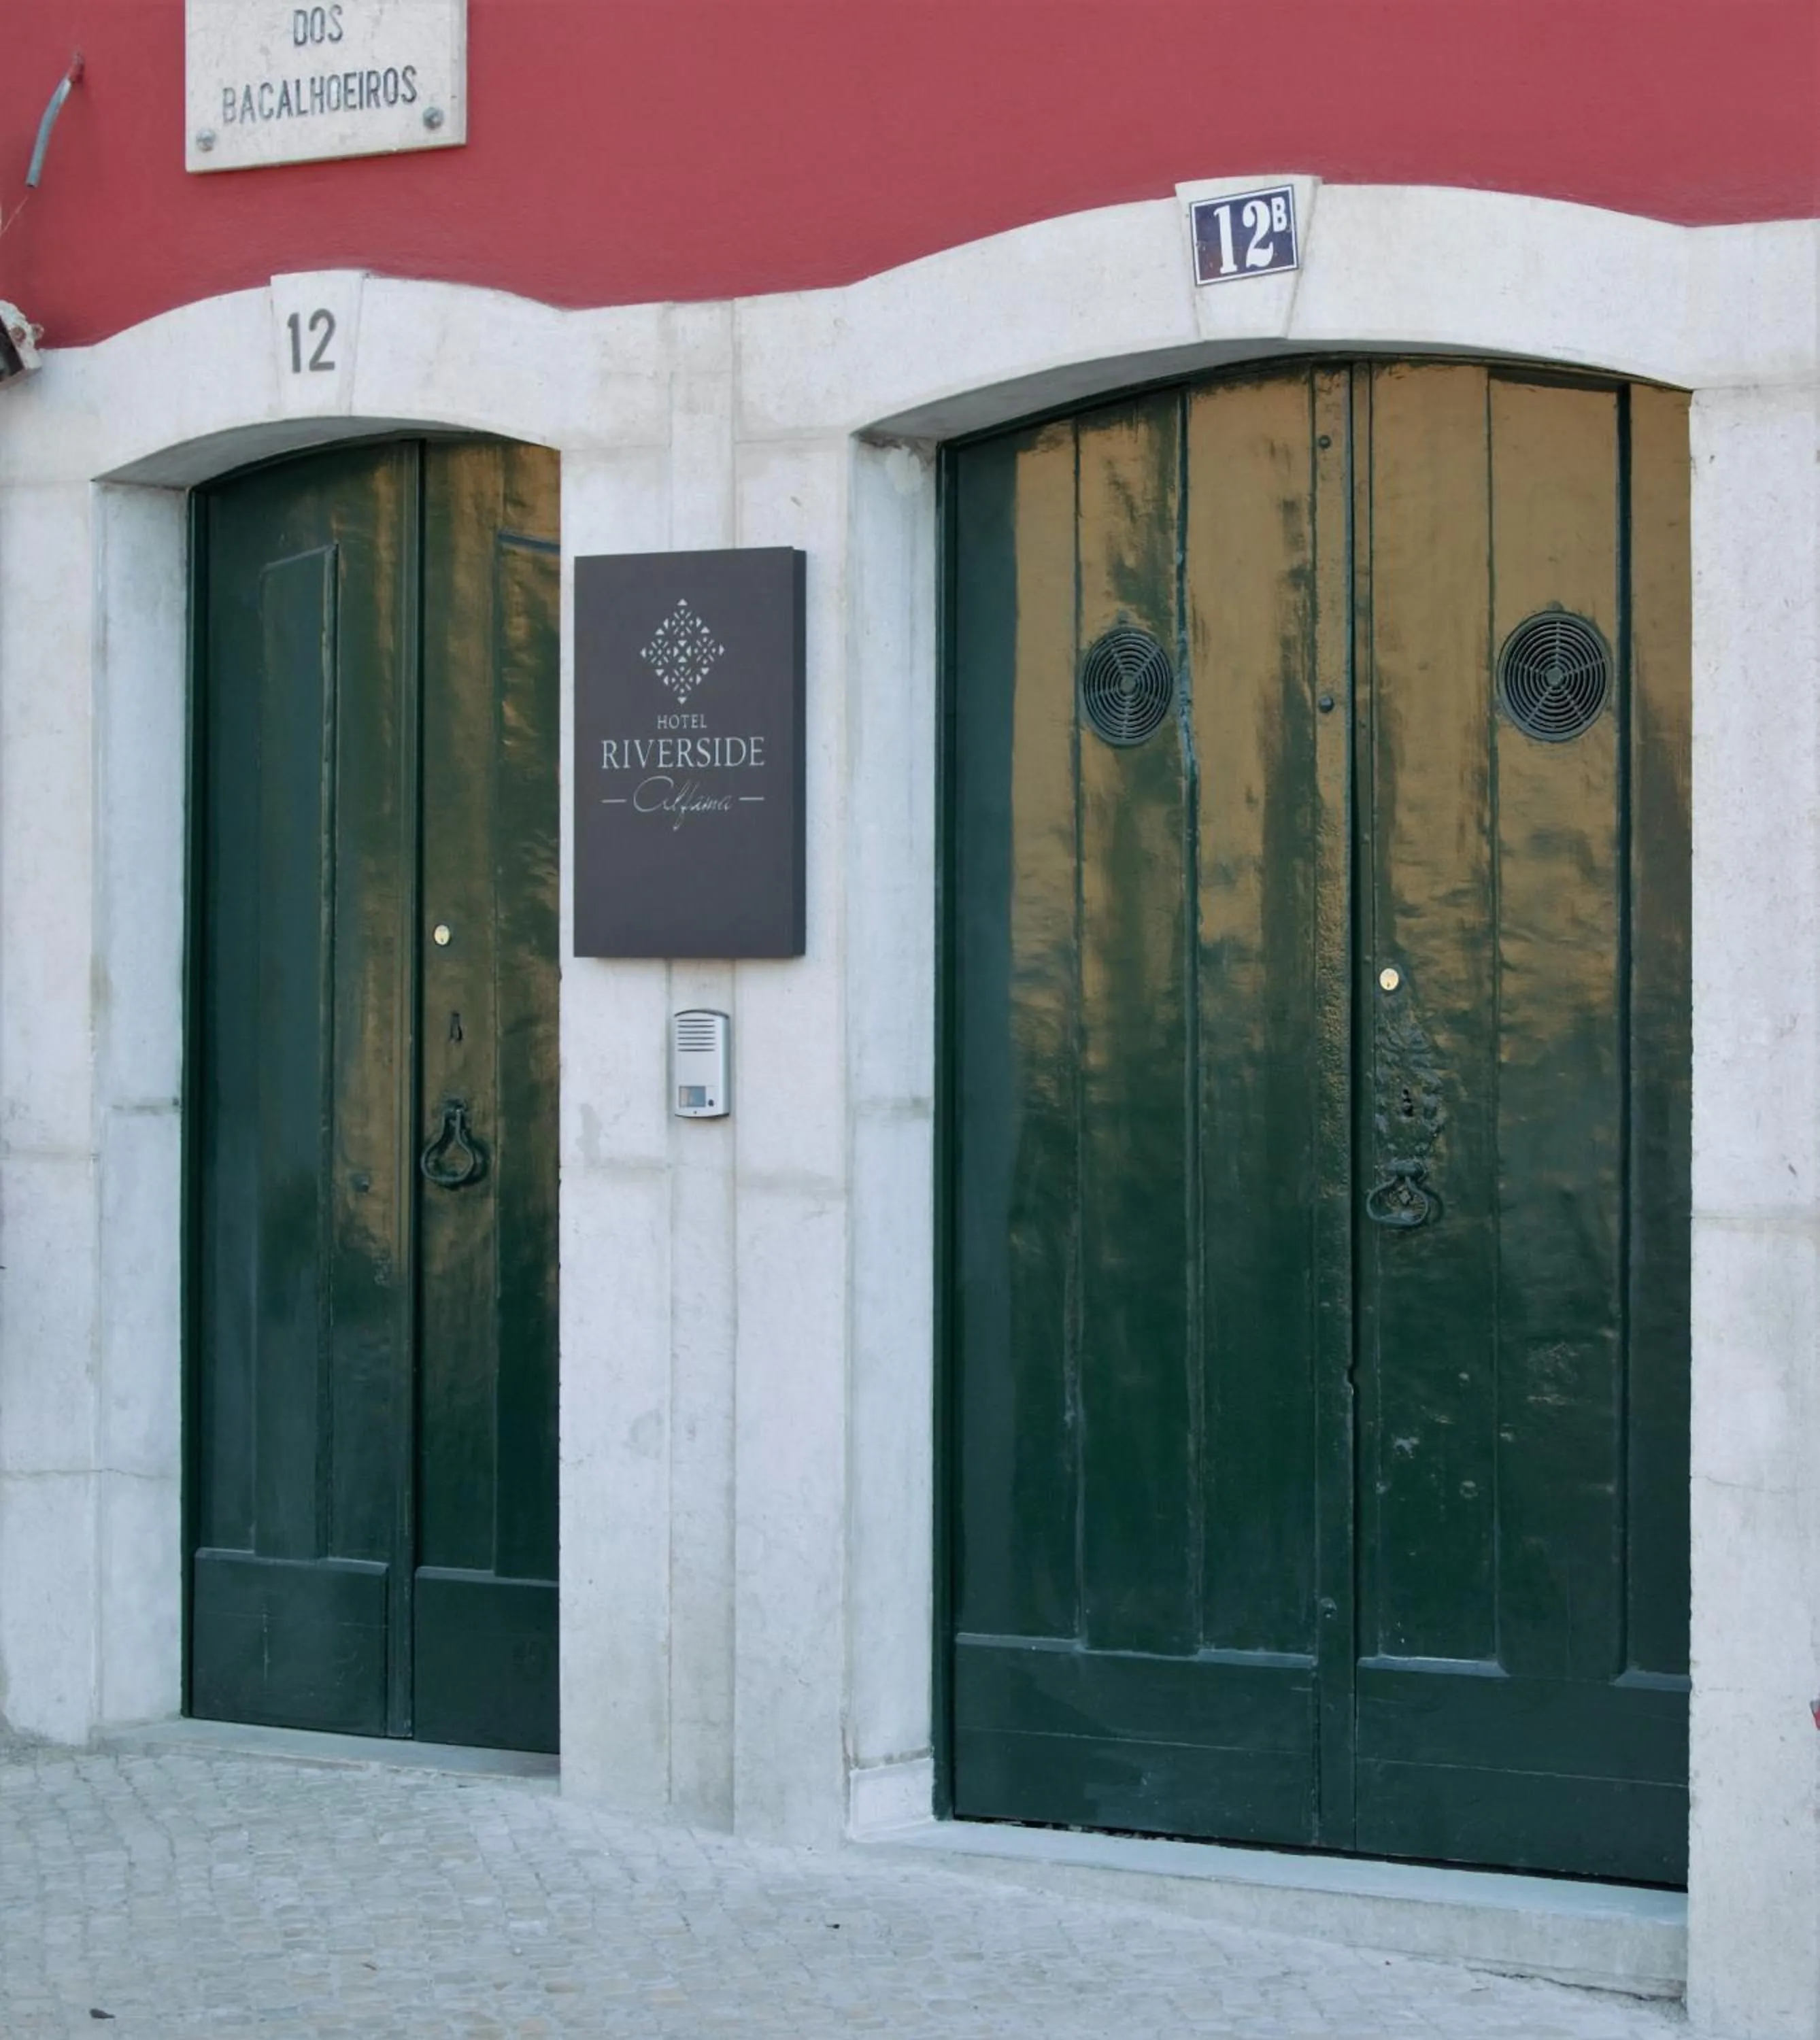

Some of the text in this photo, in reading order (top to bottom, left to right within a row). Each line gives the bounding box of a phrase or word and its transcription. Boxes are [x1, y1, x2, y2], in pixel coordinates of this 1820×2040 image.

[293, 4, 344, 46] DOS
[222, 65, 417, 124] BACALHOEIROS
[287, 309, 336, 373] 12
[657, 714, 707, 729] HOTEL
[601, 736, 765, 769] RIVERSIDE
